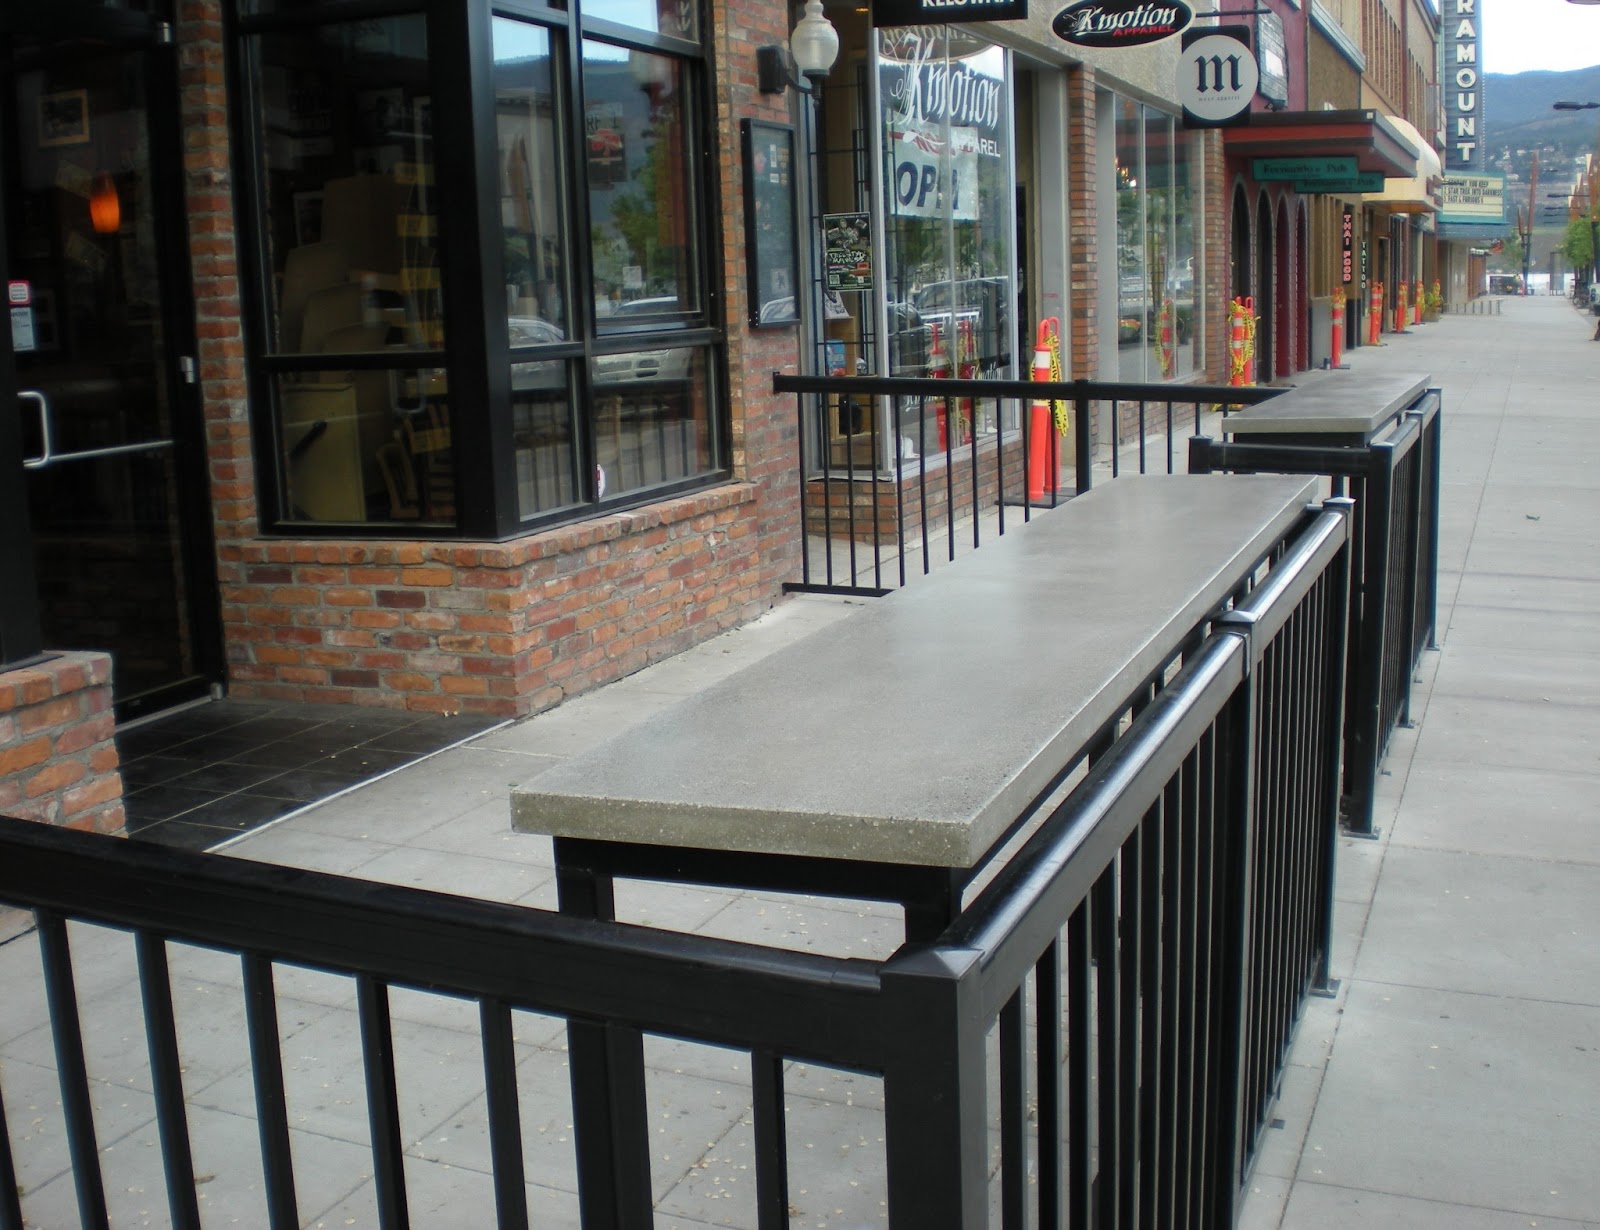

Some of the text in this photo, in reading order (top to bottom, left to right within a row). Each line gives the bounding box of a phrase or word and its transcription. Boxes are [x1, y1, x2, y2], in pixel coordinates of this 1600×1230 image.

[1066, 3, 1178, 36] Kmotion
[1112, 25, 1176, 37] APPAREL
[887, 32, 1000, 129] Kmotion
[1455, 0, 1477, 163] RAMOUNT
[951, 130, 1001, 158] APPAREL
[896, 161, 960, 210] OP
[1343, 214, 1352, 281] THAI FOOD
